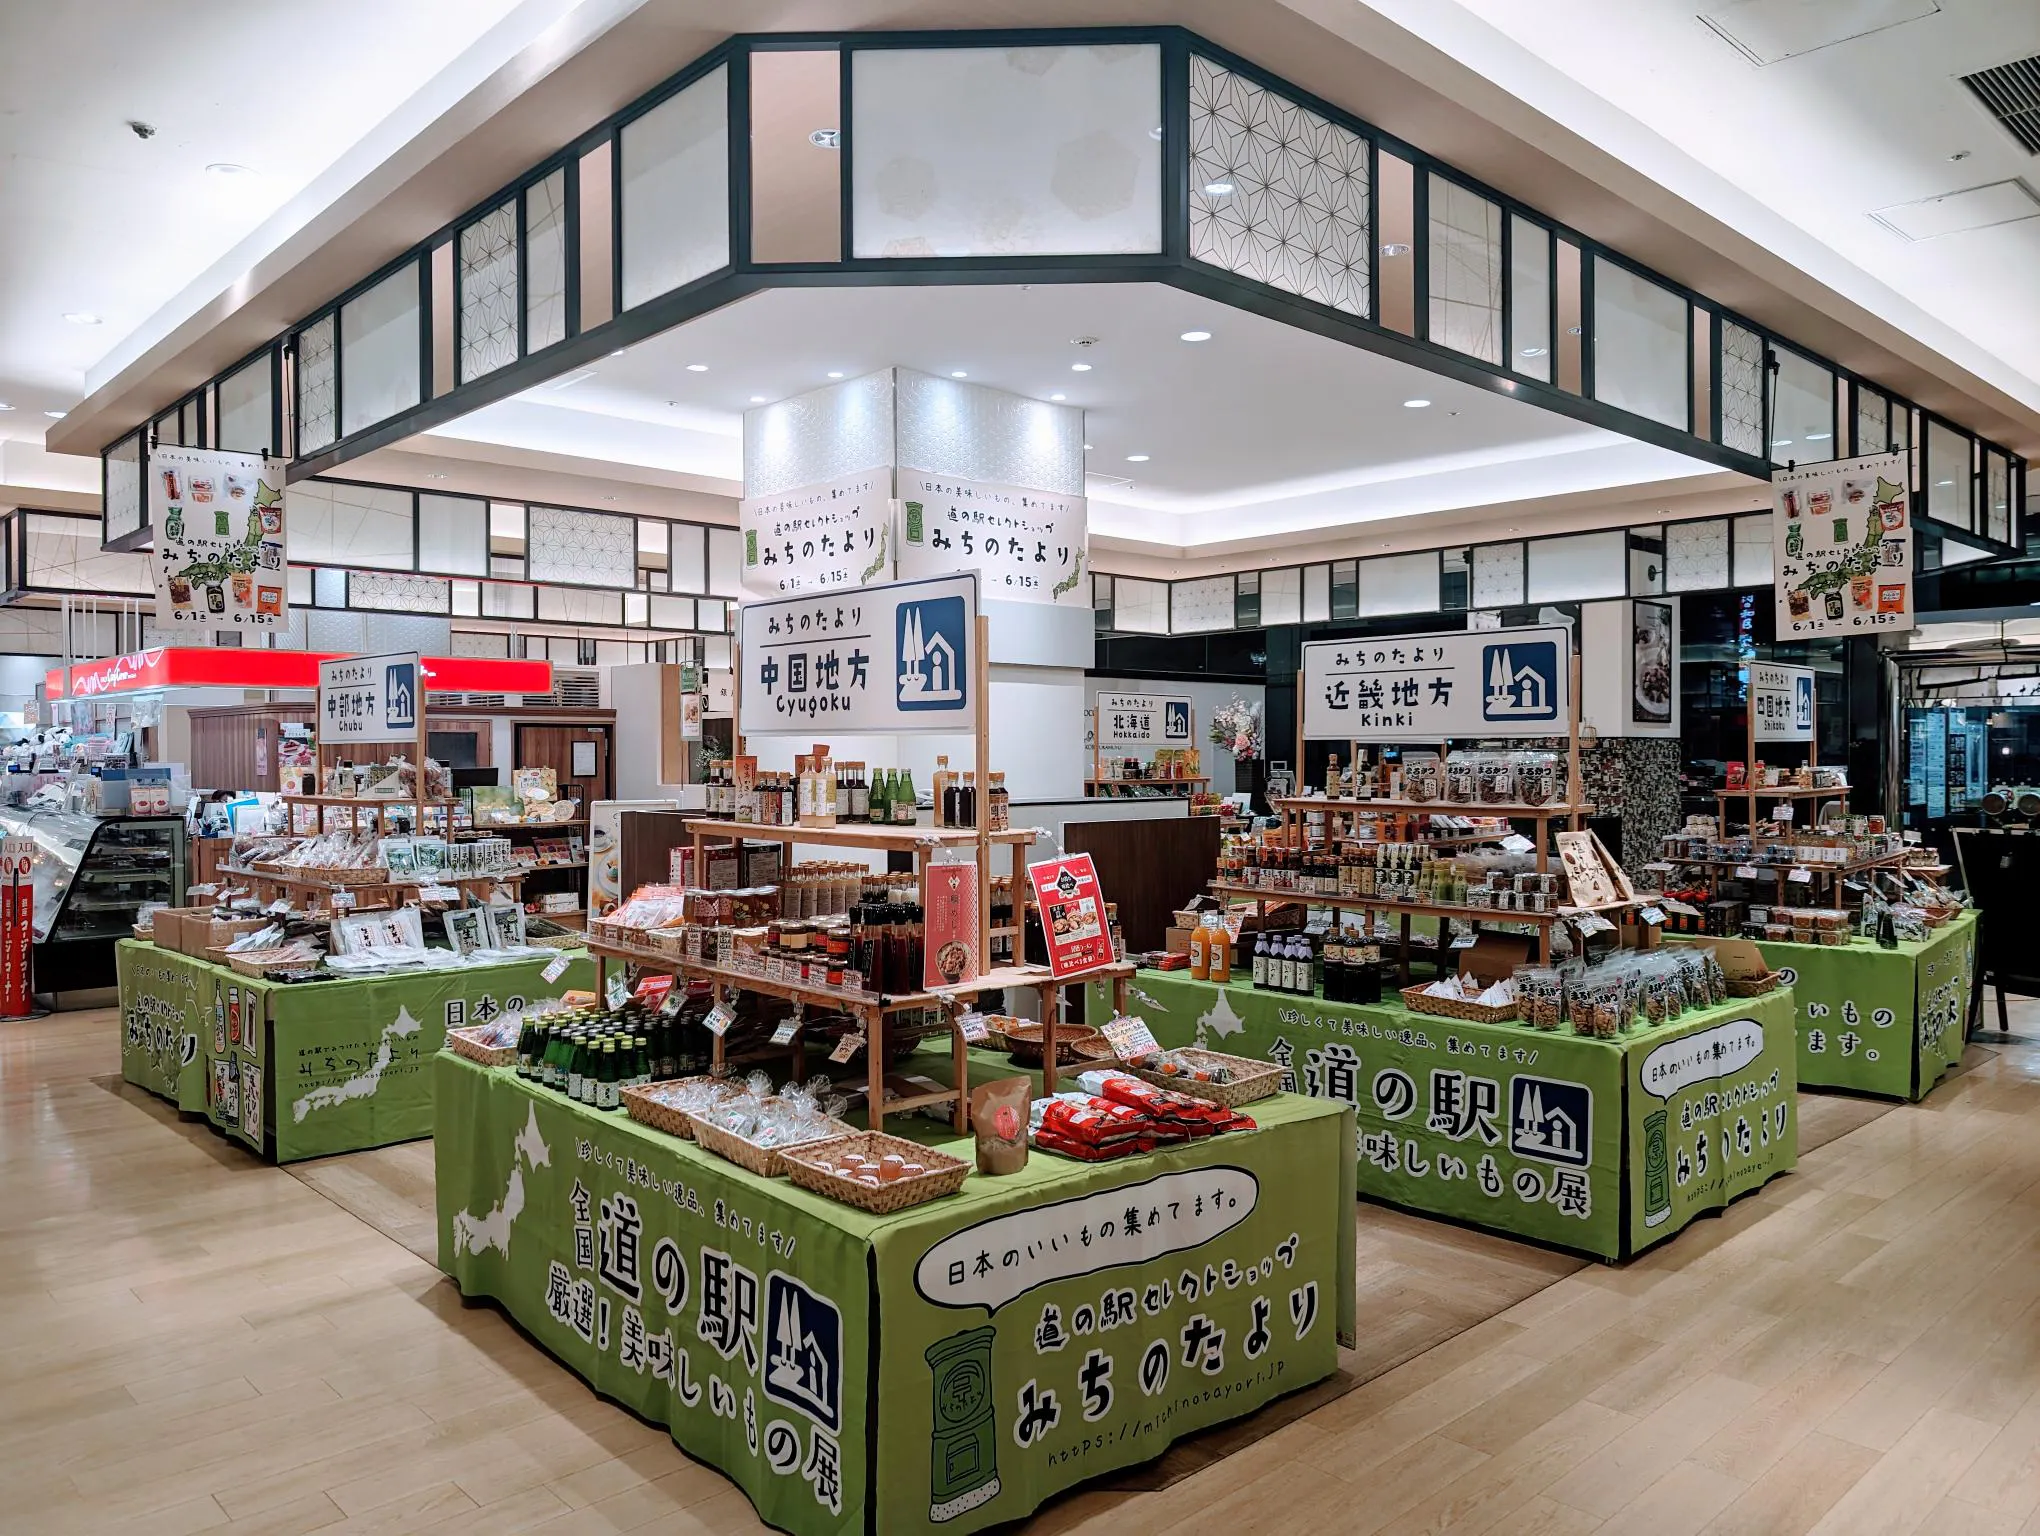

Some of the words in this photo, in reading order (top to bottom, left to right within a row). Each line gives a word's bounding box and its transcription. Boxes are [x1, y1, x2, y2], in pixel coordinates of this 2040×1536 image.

[162, 548, 280, 568] みちのたより
[763, 527, 875, 565] みちのたより
[932, 528, 1068, 565] みちのたより
[1783, 553, 1904, 577] みちのたより
[768, 607, 861, 635] みちのたより
[1335, 647, 1444, 666] みちのたより
[331, 666, 372, 682] みちのたより
[761, 648, 870, 695] 中国地方
[328, 691, 375, 719] 中部地方
[776, 692, 851, 718] Cyugoku
[1111, 698, 1154, 708] みちのたより
[1325, 676, 1453, 710] 近畿地方
[1757, 695, 1791, 718] 四国地方
[338, 719, 363, 731] Chubu
[1113, 714, 1150, 731] 北海道
[1361, 712, 1413, 727] Kinki
[1764, 719, 1786, 731] Shikoku
[1113, 730, 1150, 739] Hokkaido
[1795, 1002, 1893, 1026] いもの
[299, 1047, 420, 1077] みちのたより
[1305, 1046, 1499, 1145] 道の駅
[1357, 1132, 1590, 1217] 味しいもの展
[570, 1180, 594, 1269] 全国
[948, 1188, 1238, 1287] 日本のいいもの集めてます。
[600, 1198, 758, 1370] 道の駅
[1035, 1235, 1299, 1351] 道の駅セレクトショップ
[1016, 1283, 1319, 1446] みちのたより
